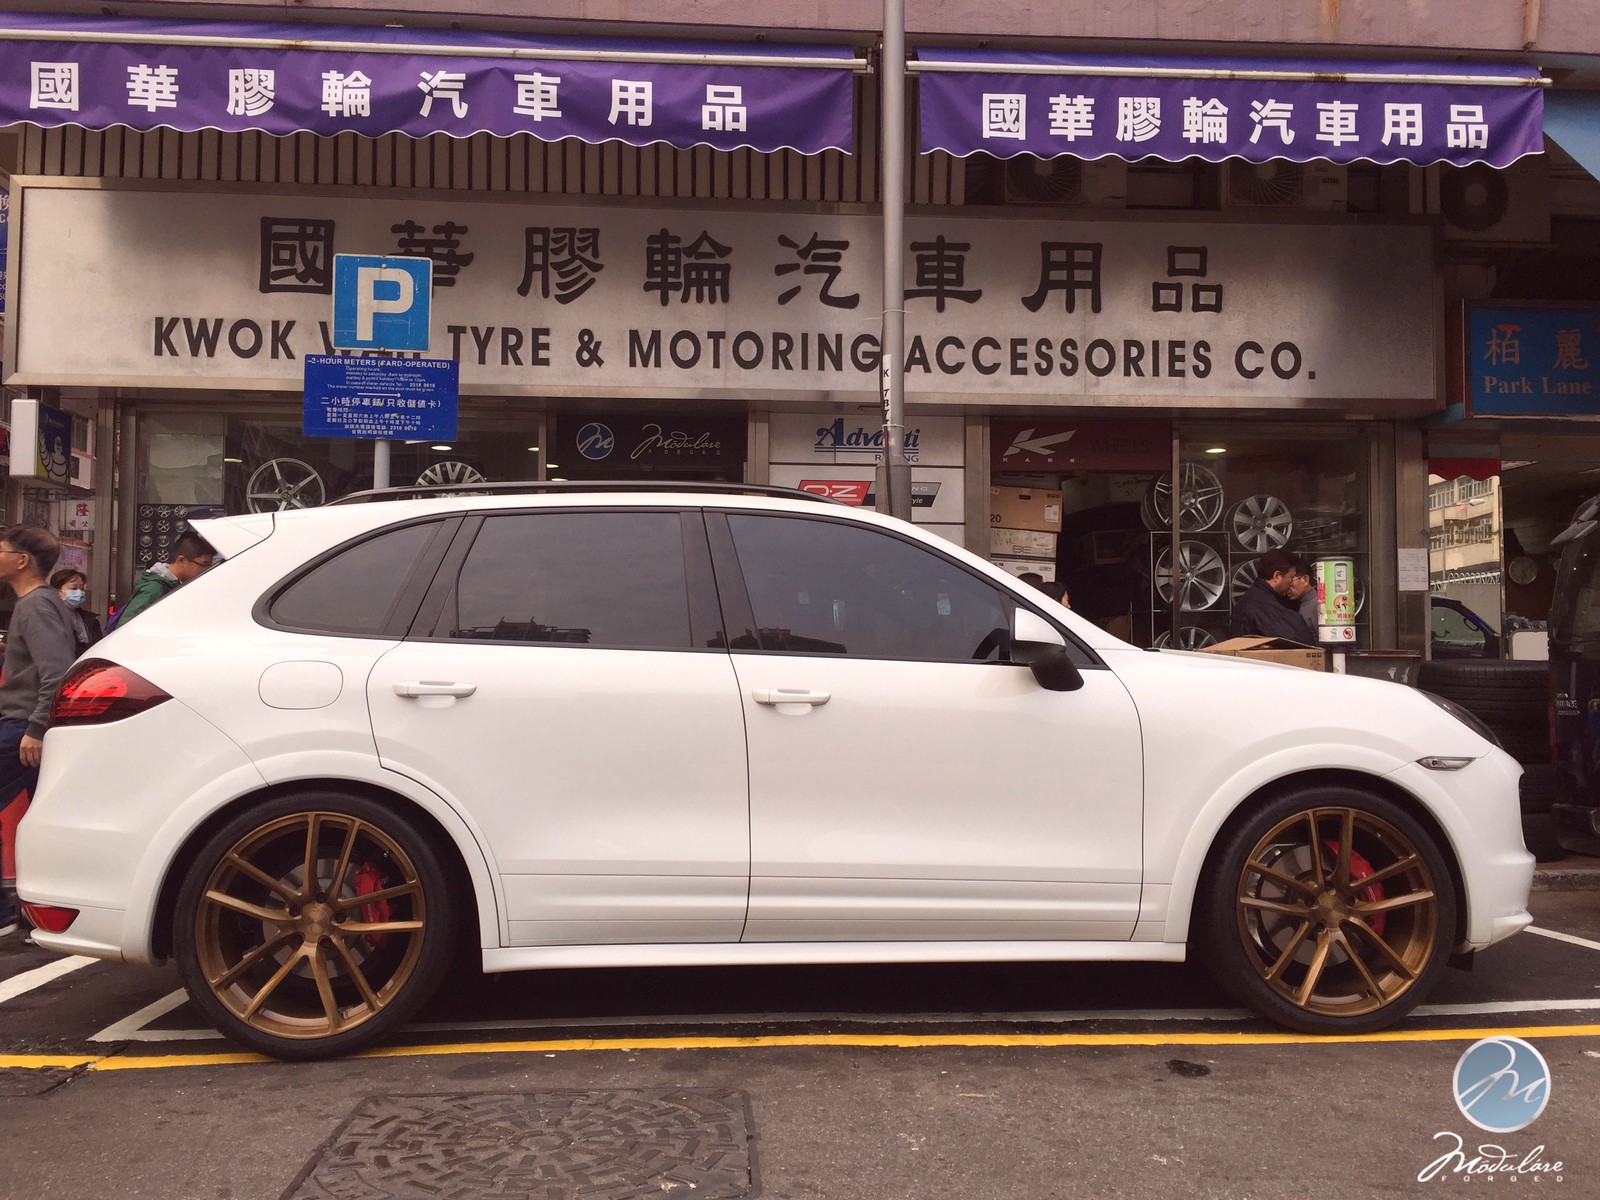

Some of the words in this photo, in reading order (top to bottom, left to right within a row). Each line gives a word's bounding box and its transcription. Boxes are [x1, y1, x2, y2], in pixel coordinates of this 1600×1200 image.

[29, 60, 748, 132] 國華膠輪汽車用品
[981, 93, 1489, 149] 國華膠輪汽車用品
[259, 216, 1224, 313] 國華膠輪汽車用品
[356, 266, 413, 341] P
[154, 316, 296, 360] KWOK
[447, 325, 551, 367] TYRE
[575, 329, 604, 368] &
[628, 328, 882, 373] MOTORING
[903, 334, 1213, 380] ACCESSORIES
[1234, 340, 1317, 381] CO.
[344, 358, 376, 366] METERS
[1484, 376, 1533, 395] Park
[1542, 376, 1592, 395] Lane
[815, 418, 921, 448] Advati
